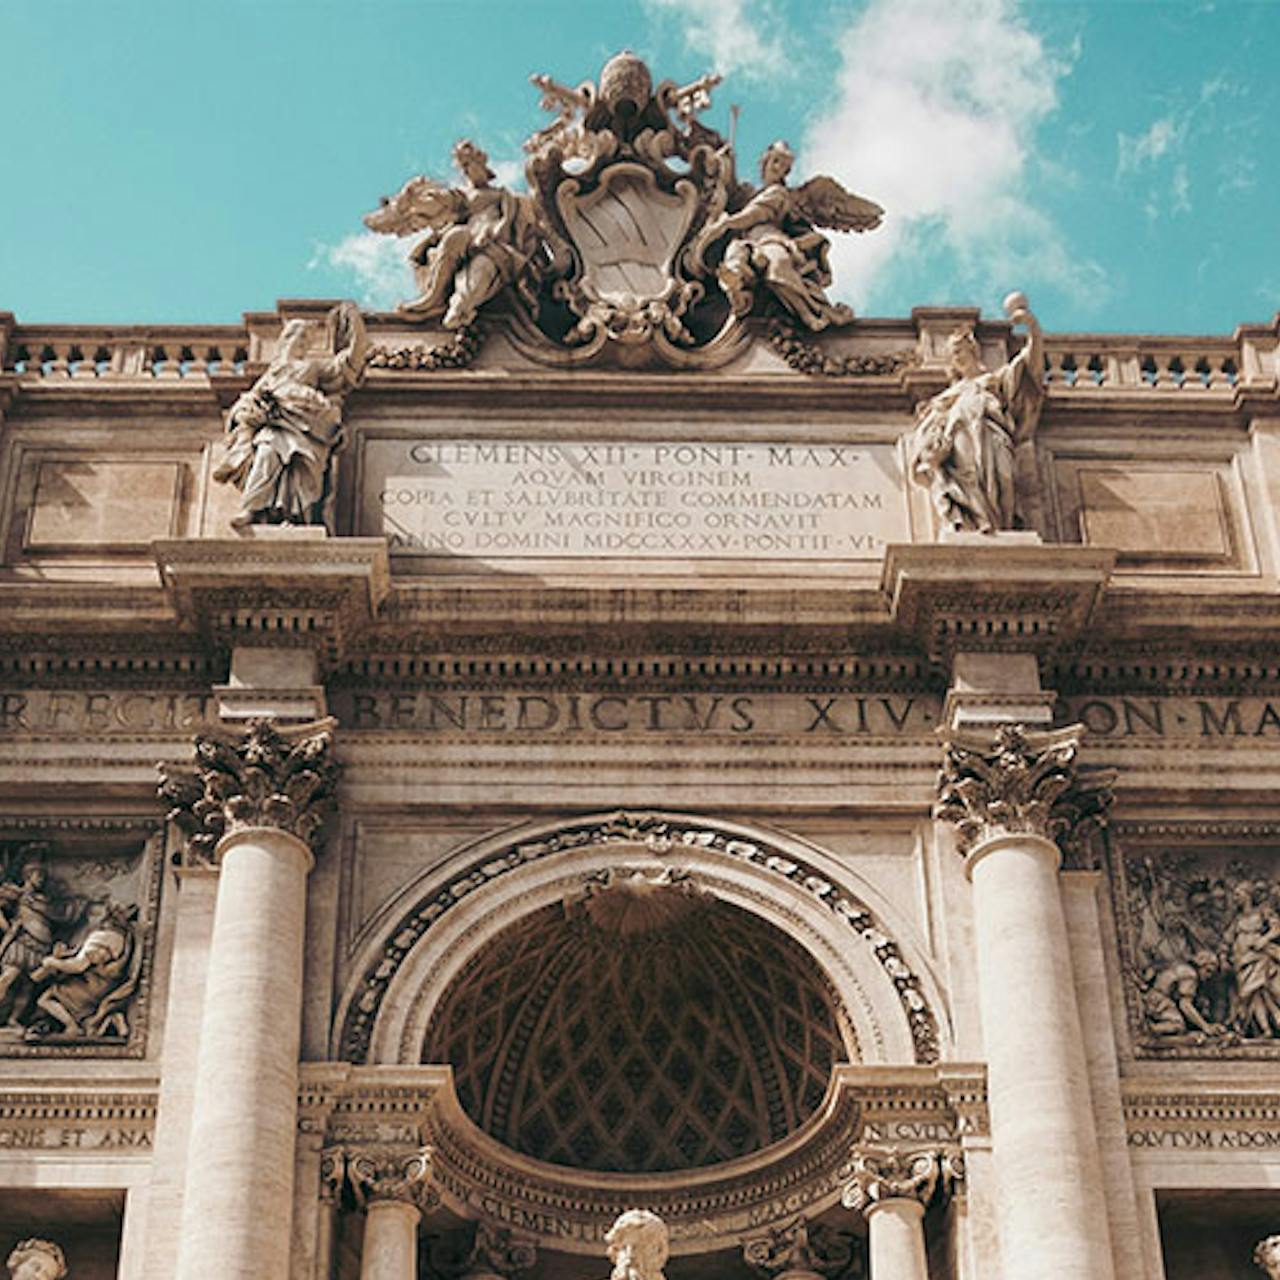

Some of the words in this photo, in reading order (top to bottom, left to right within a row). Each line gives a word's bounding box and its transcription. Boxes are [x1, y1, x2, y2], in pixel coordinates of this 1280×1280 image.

[410, 444, 562, 465] CLEMENS
[512, 470, 605, 489] AQVAM
[622, 471, 752, 487] VIRGINEM
[379, 489, 454, 505] COPIA
[466, 489, 495, 506] ET
[504, 489, 668, 508] SALVBRITATE
[680, 491, 882, 509] COMMENDATAM
[442, 511, 528, 527] CVLTV
[544, 511, 692, 528] MAGNIFICO
[704, 512, 822, 530] ORNAVIT
[387, 533, 465, 549] ANNO
[475, 532, 570, 549] DOMINI
[350, 695, 754, 733] BENEDICTVS
[61, 1128, 86, 1147] ET
